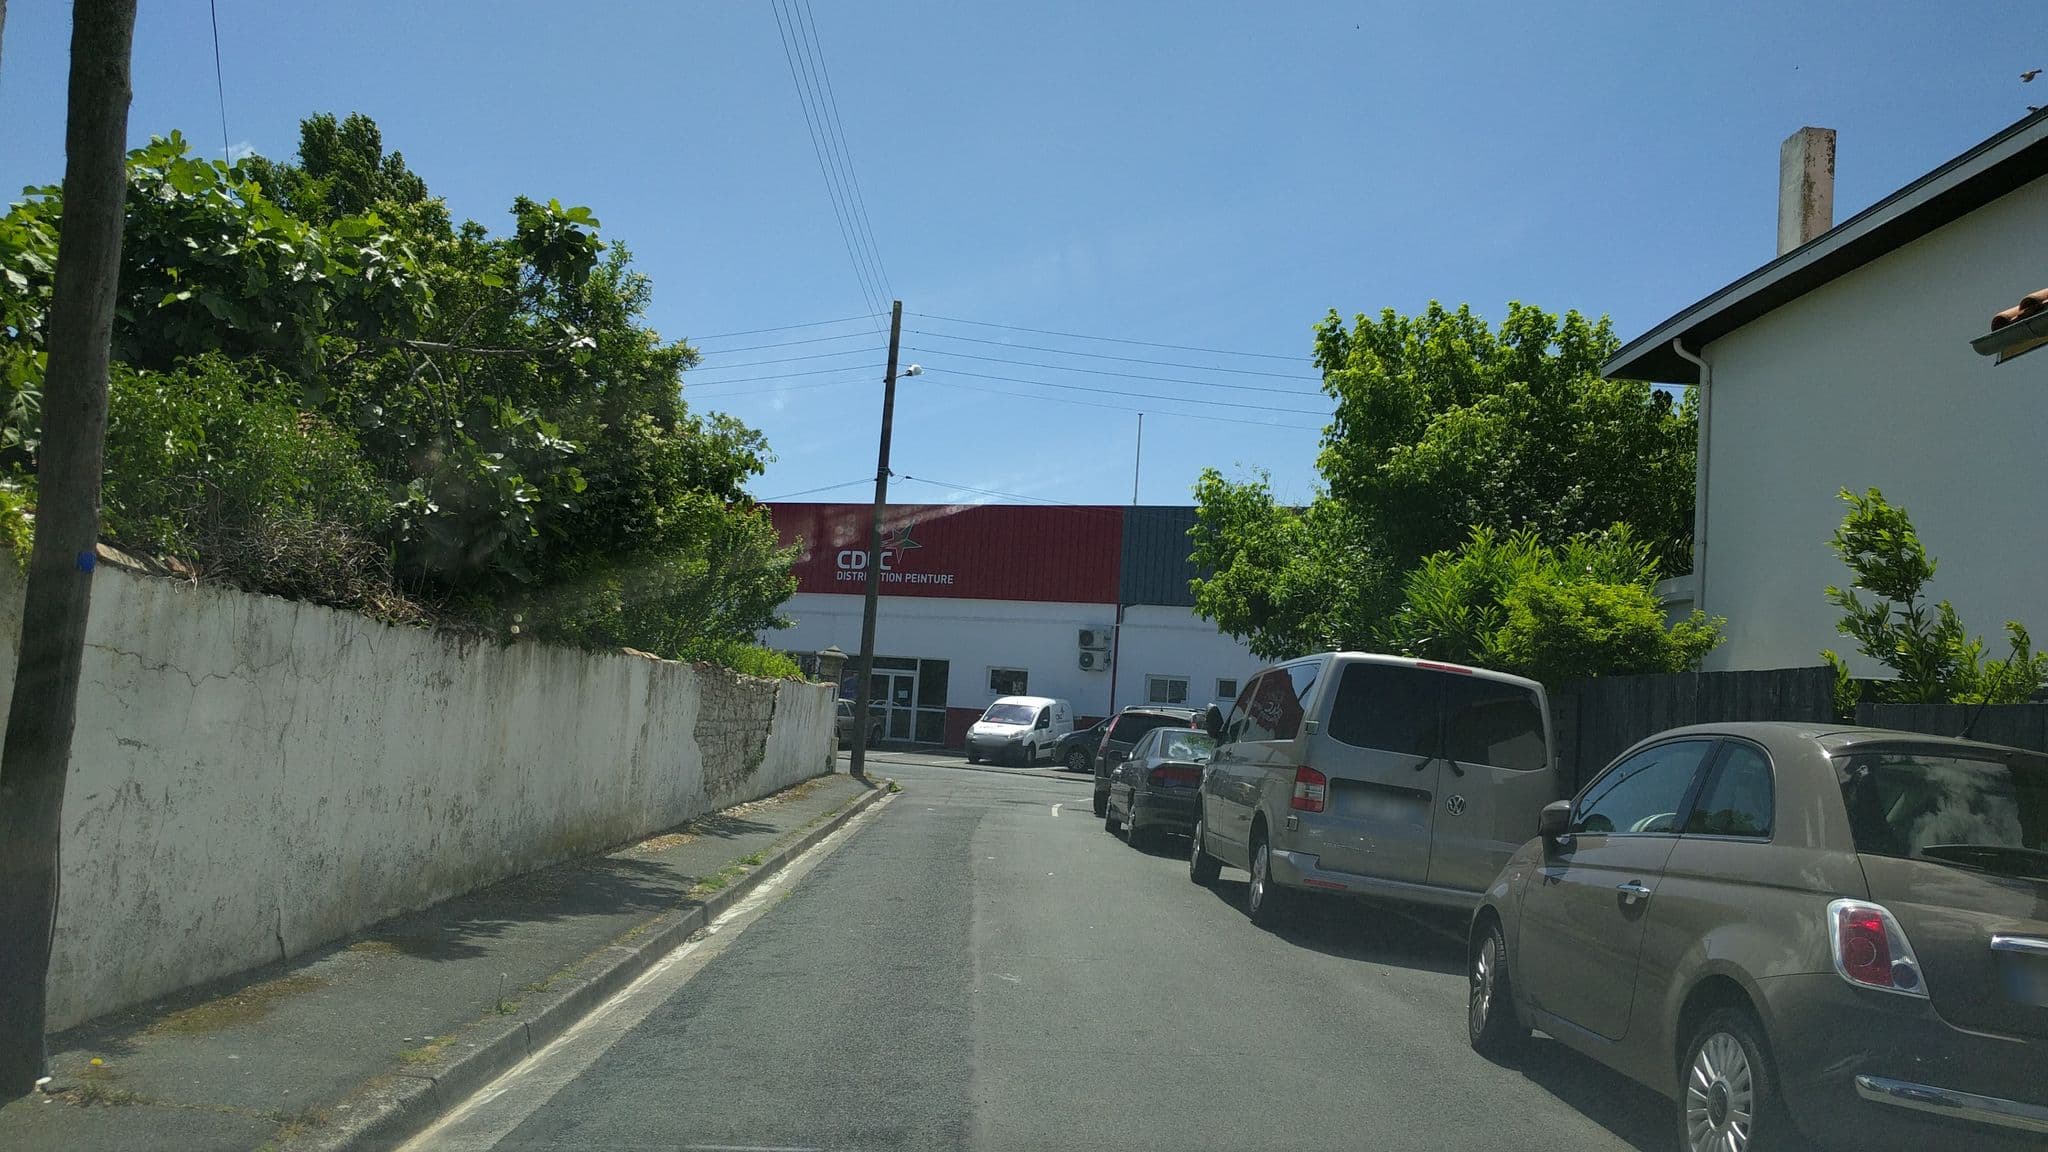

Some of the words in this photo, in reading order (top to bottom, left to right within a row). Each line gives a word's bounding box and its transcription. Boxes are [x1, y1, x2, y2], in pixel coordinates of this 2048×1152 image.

[837, 550, 893, 571] CDC
[836, 571, 903, 583] DISTRITION
[905, 573, 954, 584] PEINTURE
